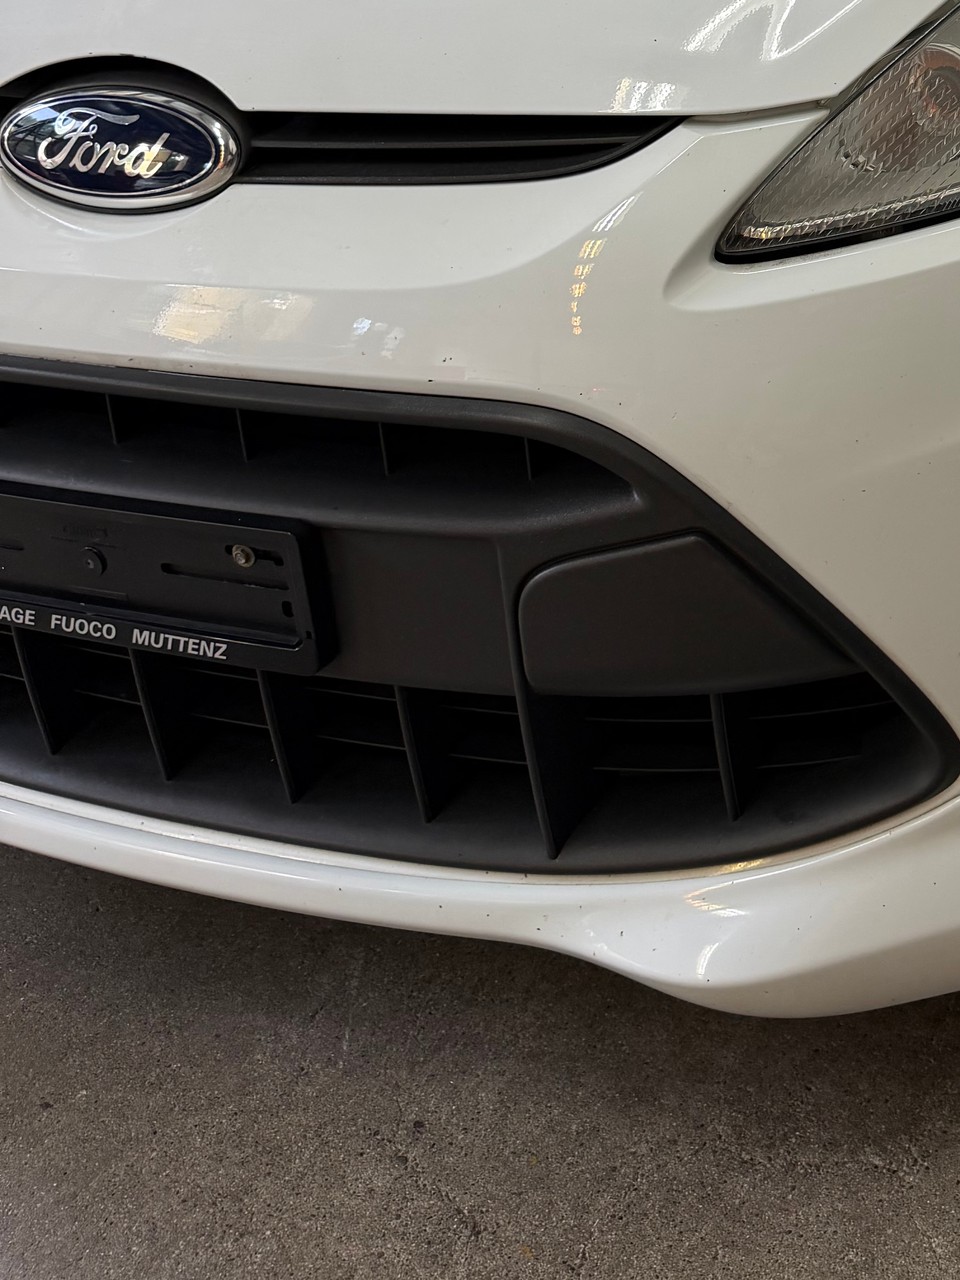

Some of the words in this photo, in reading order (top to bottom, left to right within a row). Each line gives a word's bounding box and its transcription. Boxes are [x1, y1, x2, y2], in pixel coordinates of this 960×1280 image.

[38, 107, 170, 179] Ford
[0, 605, 36, 625] AGE
[50, 614, 117, 639] FUOCO
[132, 628, 228, 660] MUTTENZ
